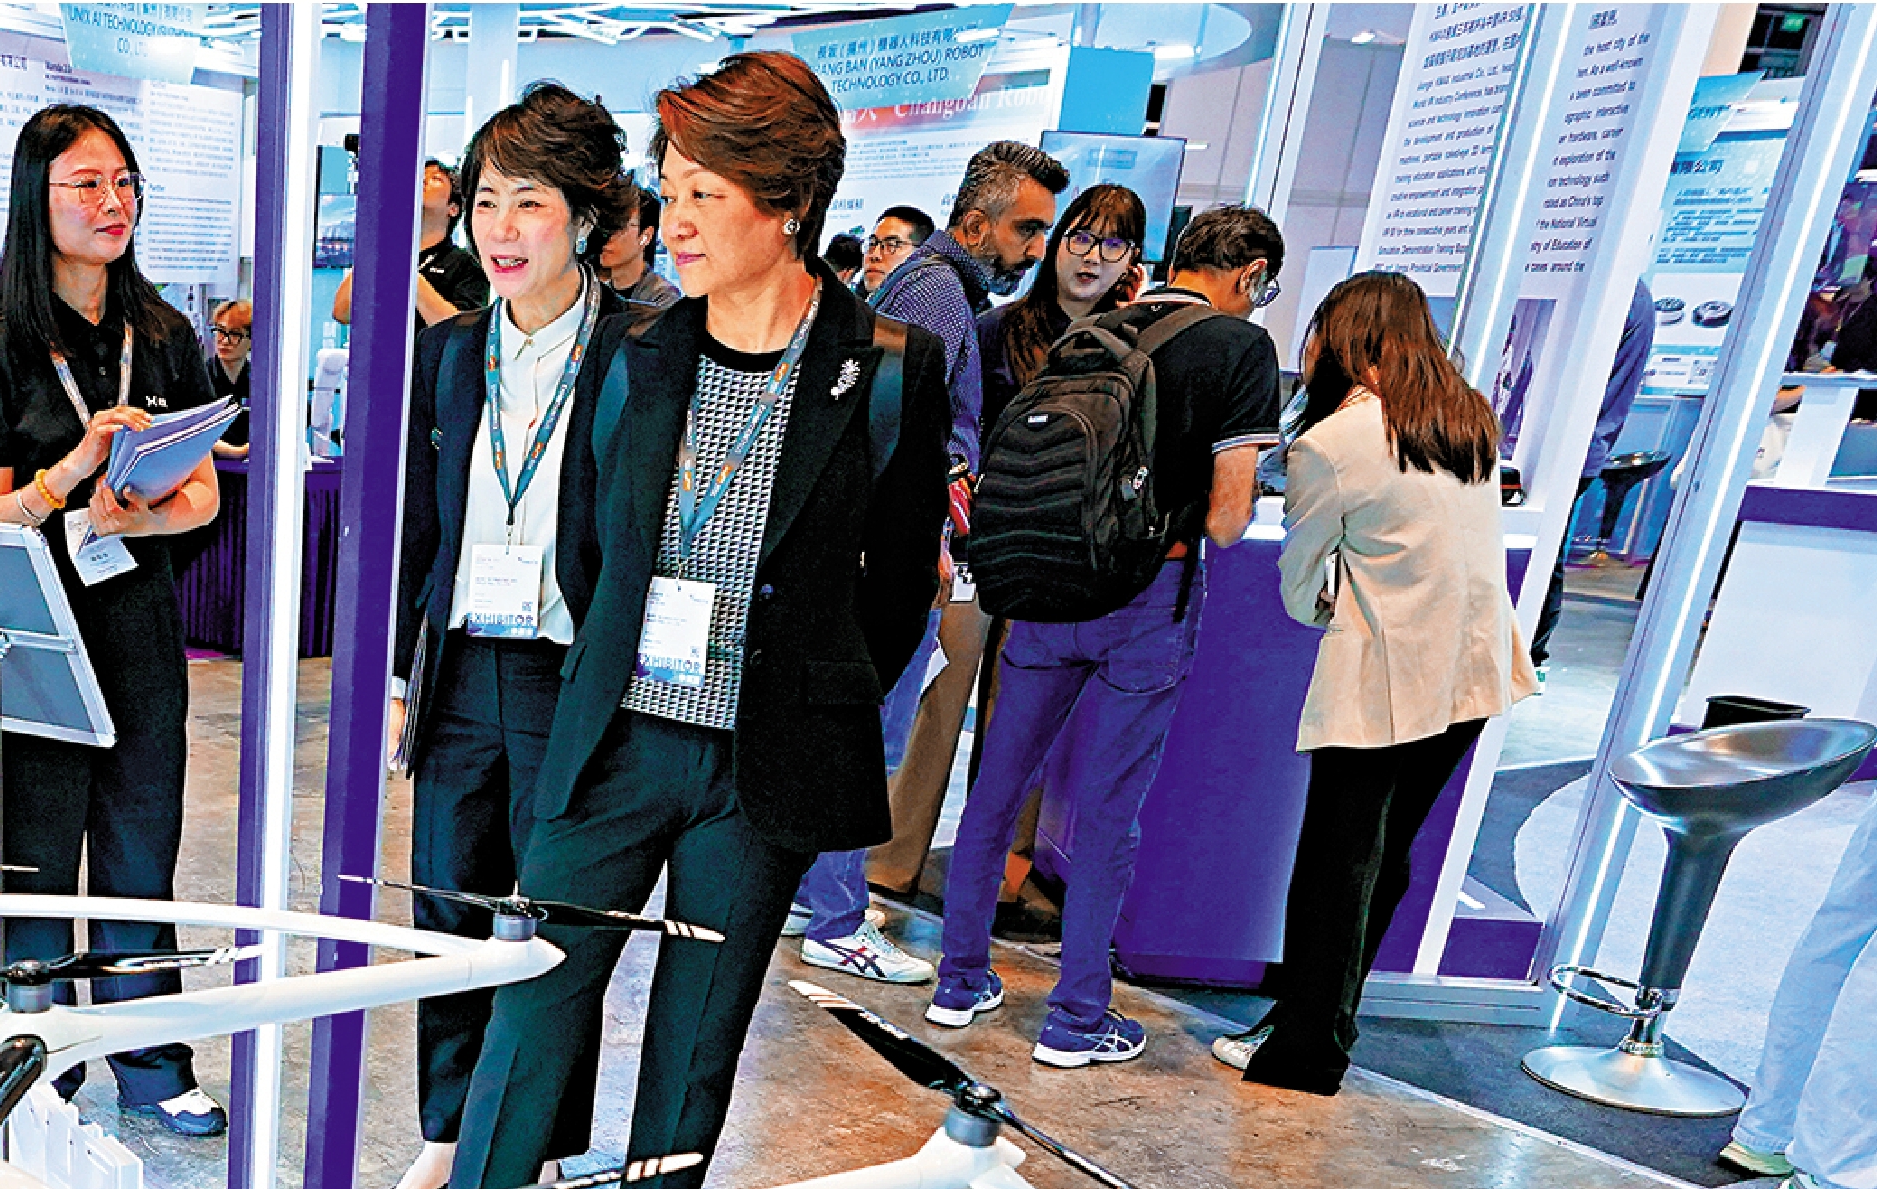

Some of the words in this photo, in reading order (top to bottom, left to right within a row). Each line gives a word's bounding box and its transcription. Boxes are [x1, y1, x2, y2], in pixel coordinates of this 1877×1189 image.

[103, 13, 156, 37] TECHNOLOGY
[845, 56, 868, 73] BAN
[944, 43, 985, 61] ROBOT
[832, 73, 903, 94] TECHNOLOGY
[1592, 80, 1627, 96] committed
[1558, 174, 1592, 188] technology
[1550, 217, 1576, 229] National
[1552, 239, 1582, 251] Education
